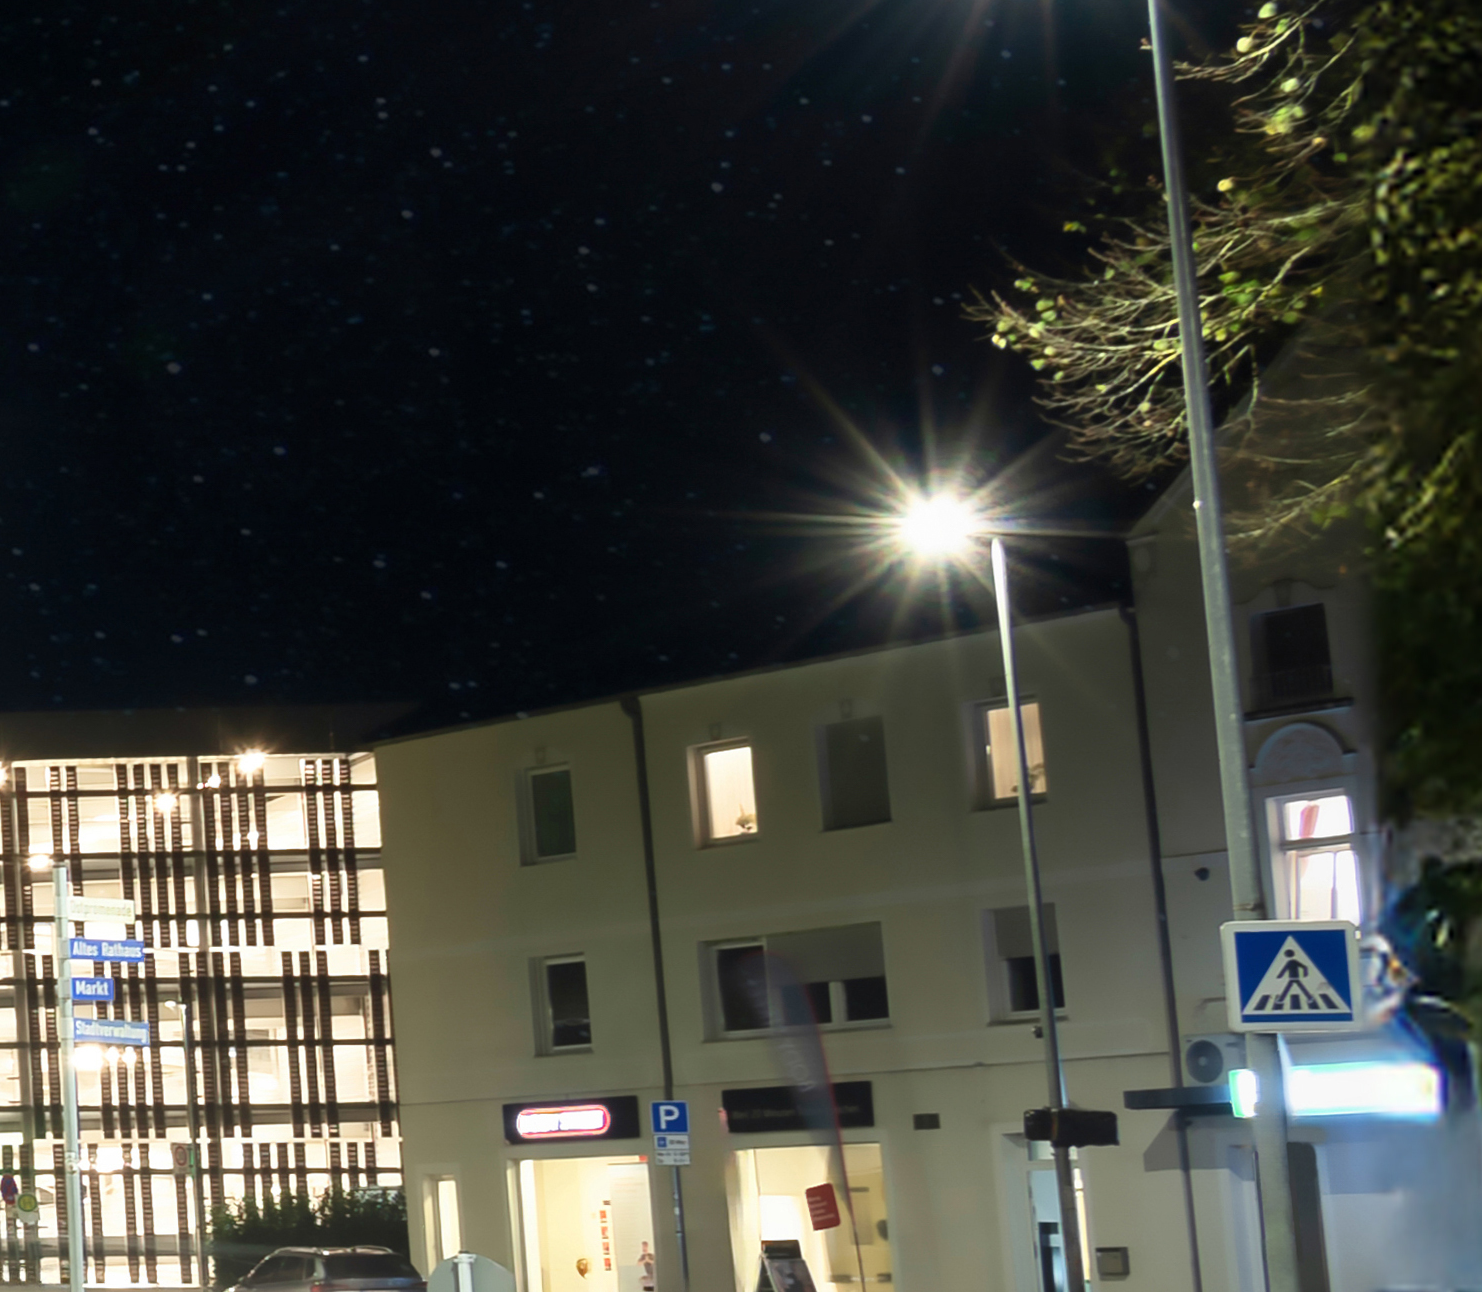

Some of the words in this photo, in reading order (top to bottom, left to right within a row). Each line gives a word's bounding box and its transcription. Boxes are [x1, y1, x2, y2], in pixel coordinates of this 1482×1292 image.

[72, 940, 99, 956] Altes
[101, 942, 143, 958] Rathaus
[75, 980, 109, 996] Markt
[75, 1020, 148, 1044] Stadtverwaltung
[659, 1105, 680, 1130] P
